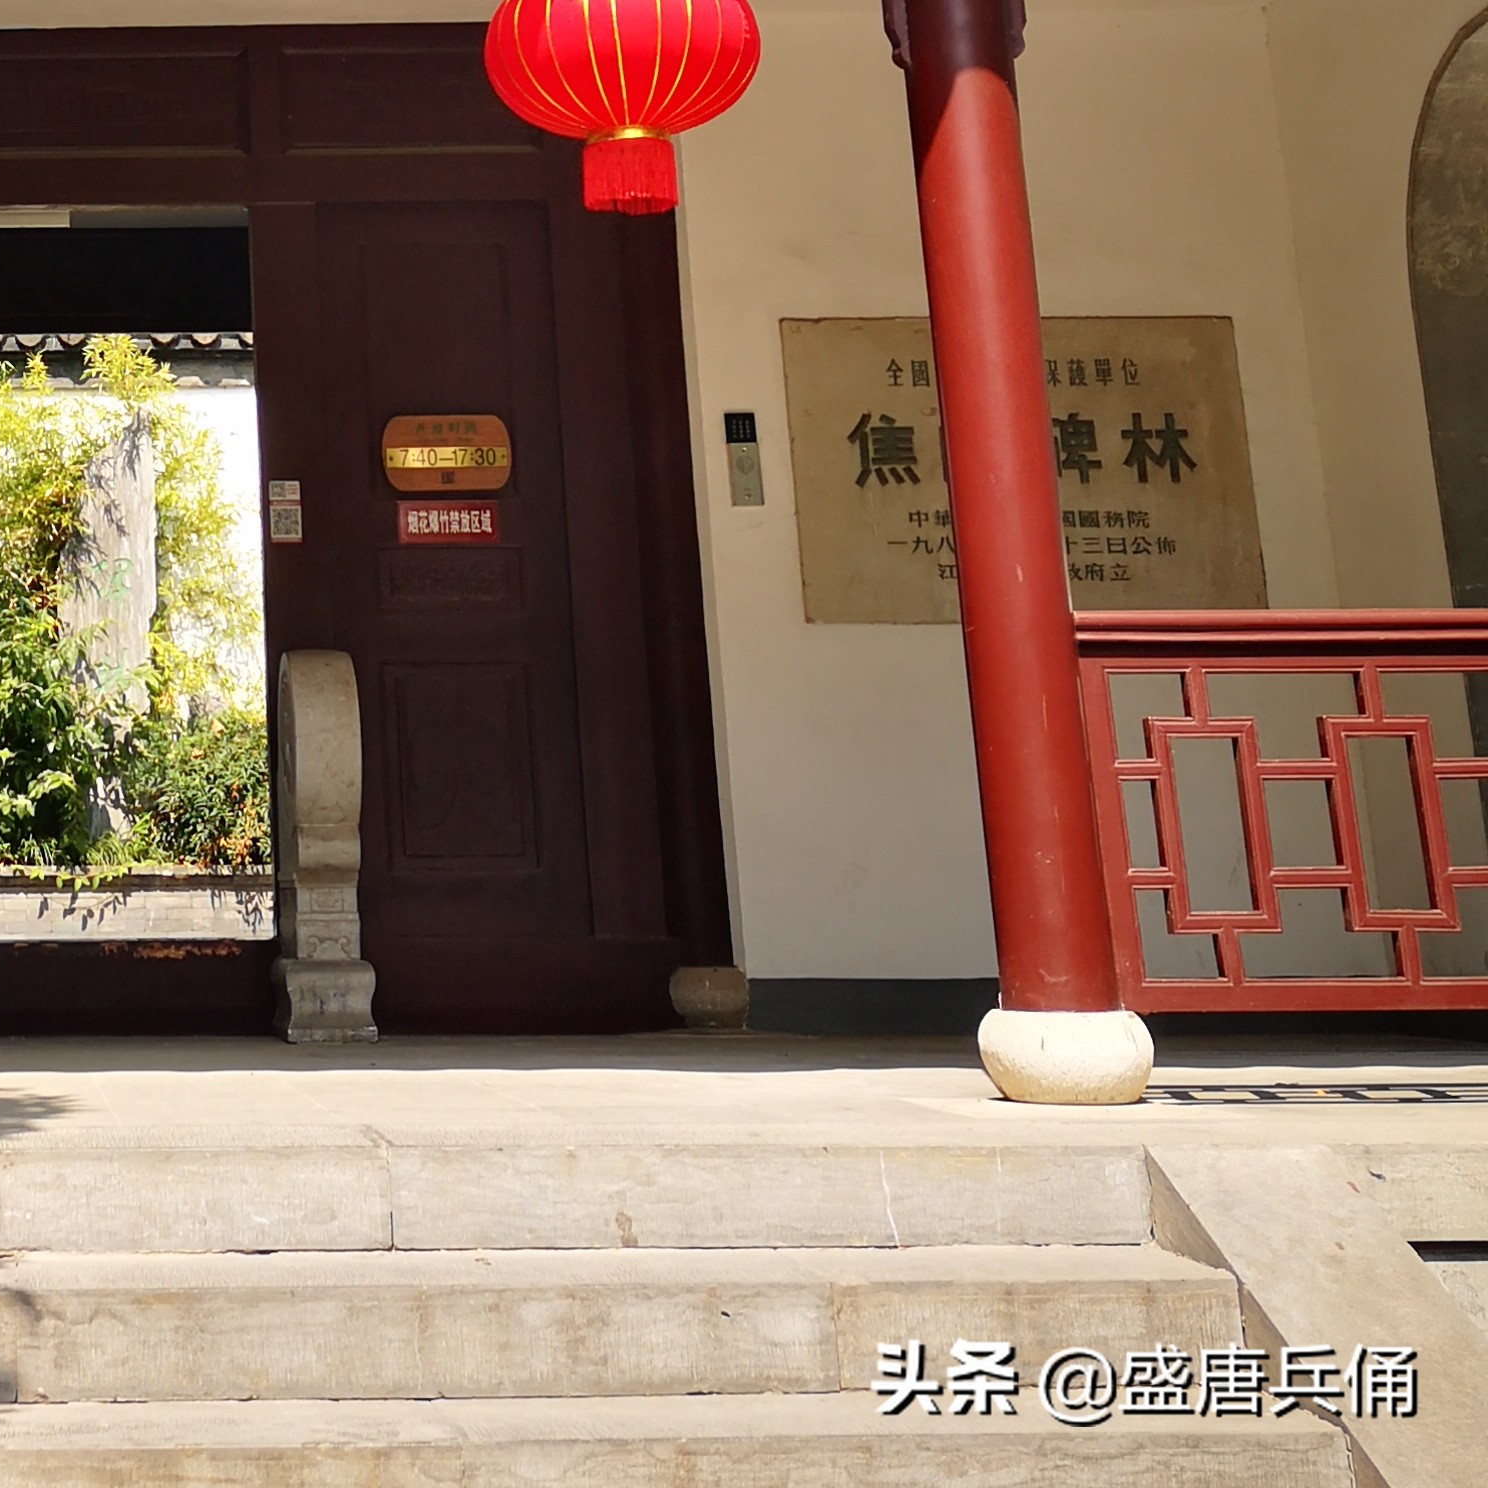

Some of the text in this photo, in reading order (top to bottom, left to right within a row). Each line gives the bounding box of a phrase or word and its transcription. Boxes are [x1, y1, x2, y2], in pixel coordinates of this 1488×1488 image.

[885, 358, 1141, 388] 全國保護單位
[847, 411, 1197, 488] 焦碑林
[908, 510, 1151, 530] 中華國國務院
[887, 535, 1177, 556] 一九八十三日公佈
